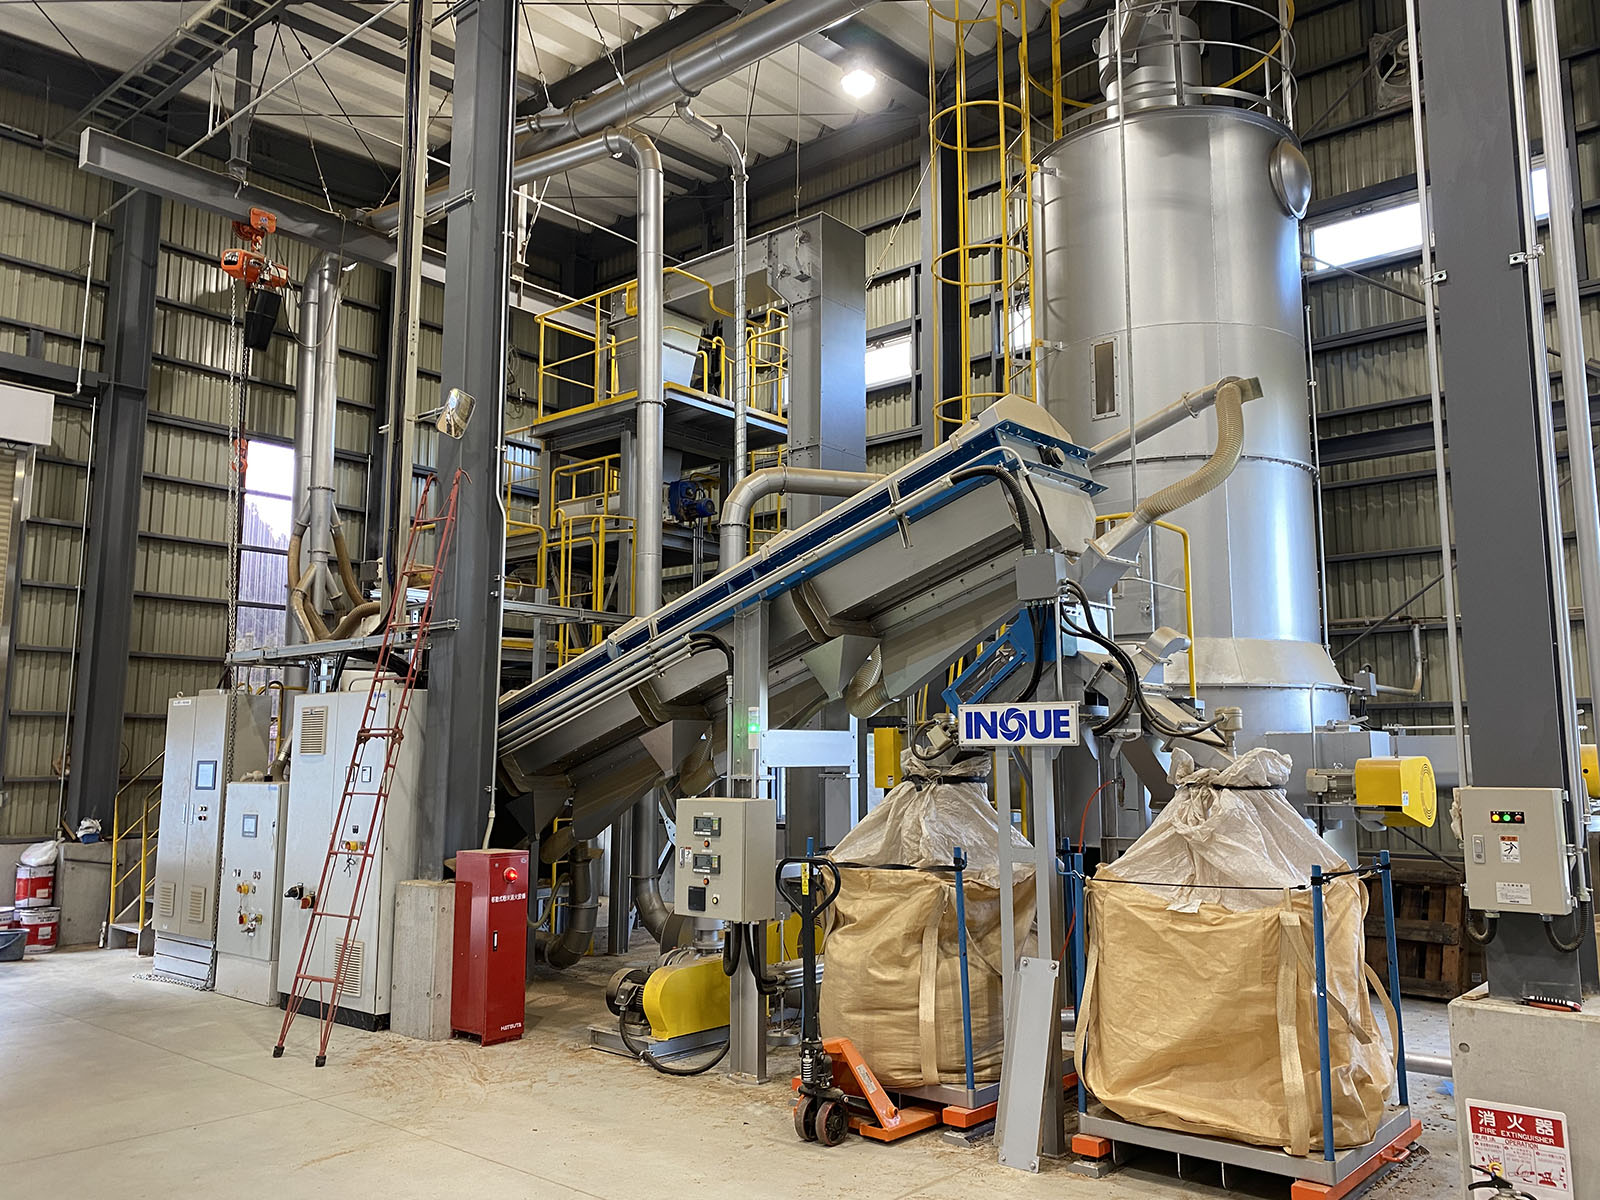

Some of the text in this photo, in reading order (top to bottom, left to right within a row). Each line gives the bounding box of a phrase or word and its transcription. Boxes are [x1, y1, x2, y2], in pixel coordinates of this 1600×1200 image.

[965, 708, 1070, 742] INOUE
[1478, 1110, 1554, 1136] 消火器
[1479, 1127, 1555, 1145] FIRE EXTINGUISHER
[1504, 1139, 1539, 1150] OPERATION
